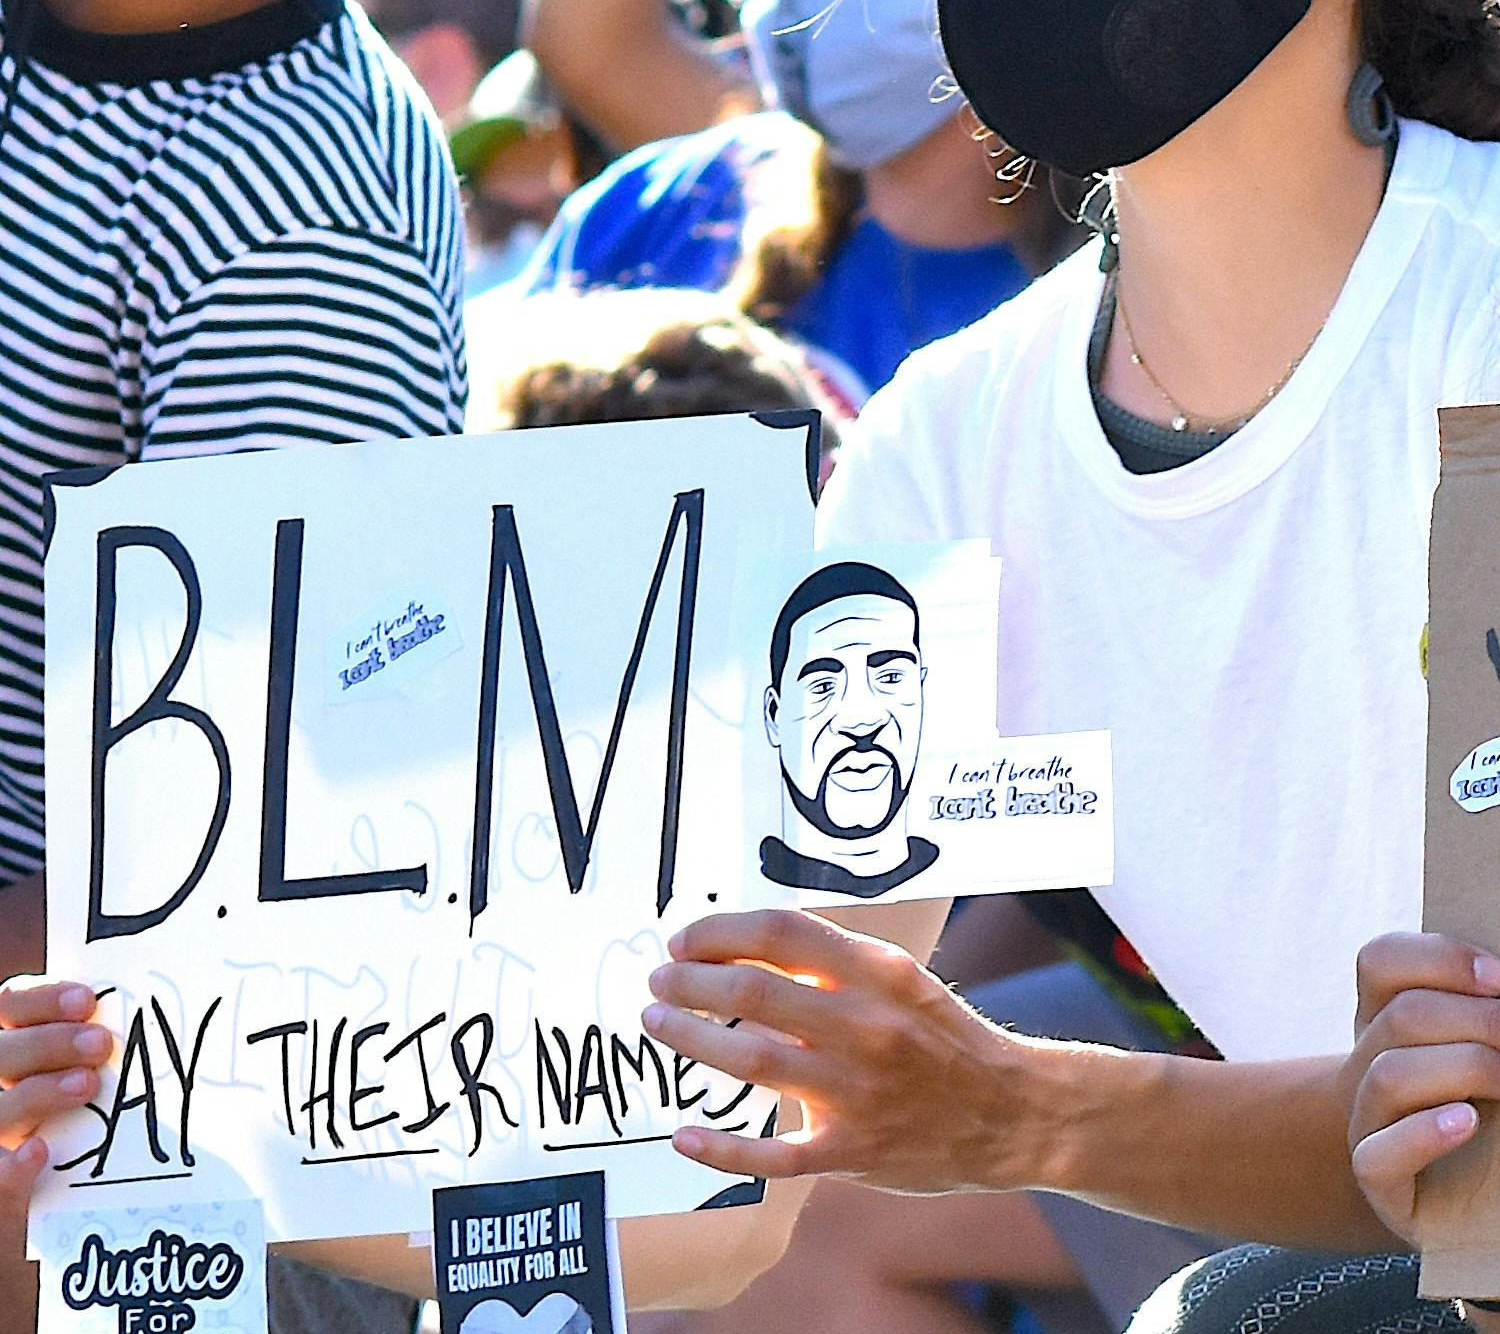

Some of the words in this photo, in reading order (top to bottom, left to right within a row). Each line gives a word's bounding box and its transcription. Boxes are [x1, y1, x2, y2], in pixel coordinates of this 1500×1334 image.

[961, 757, 1007, 784] can't
[1007, 755, 1074, 782] breathe
[247, 1010, 519, 1158] THEIR
[451, 1219, 460, 1259] I
[465, 1207, 553, 1258] BELIEVE
[558, 1200, 582, 1243] IN
[68, 1238, 239, 1303] Justice
[447, 1255, 521, 1294] EQUALITY
[524, 1250, 556, 1283] FOR
[559, 1244, 590, 1277] ALL
[125, 1307, 190, 1334] For
